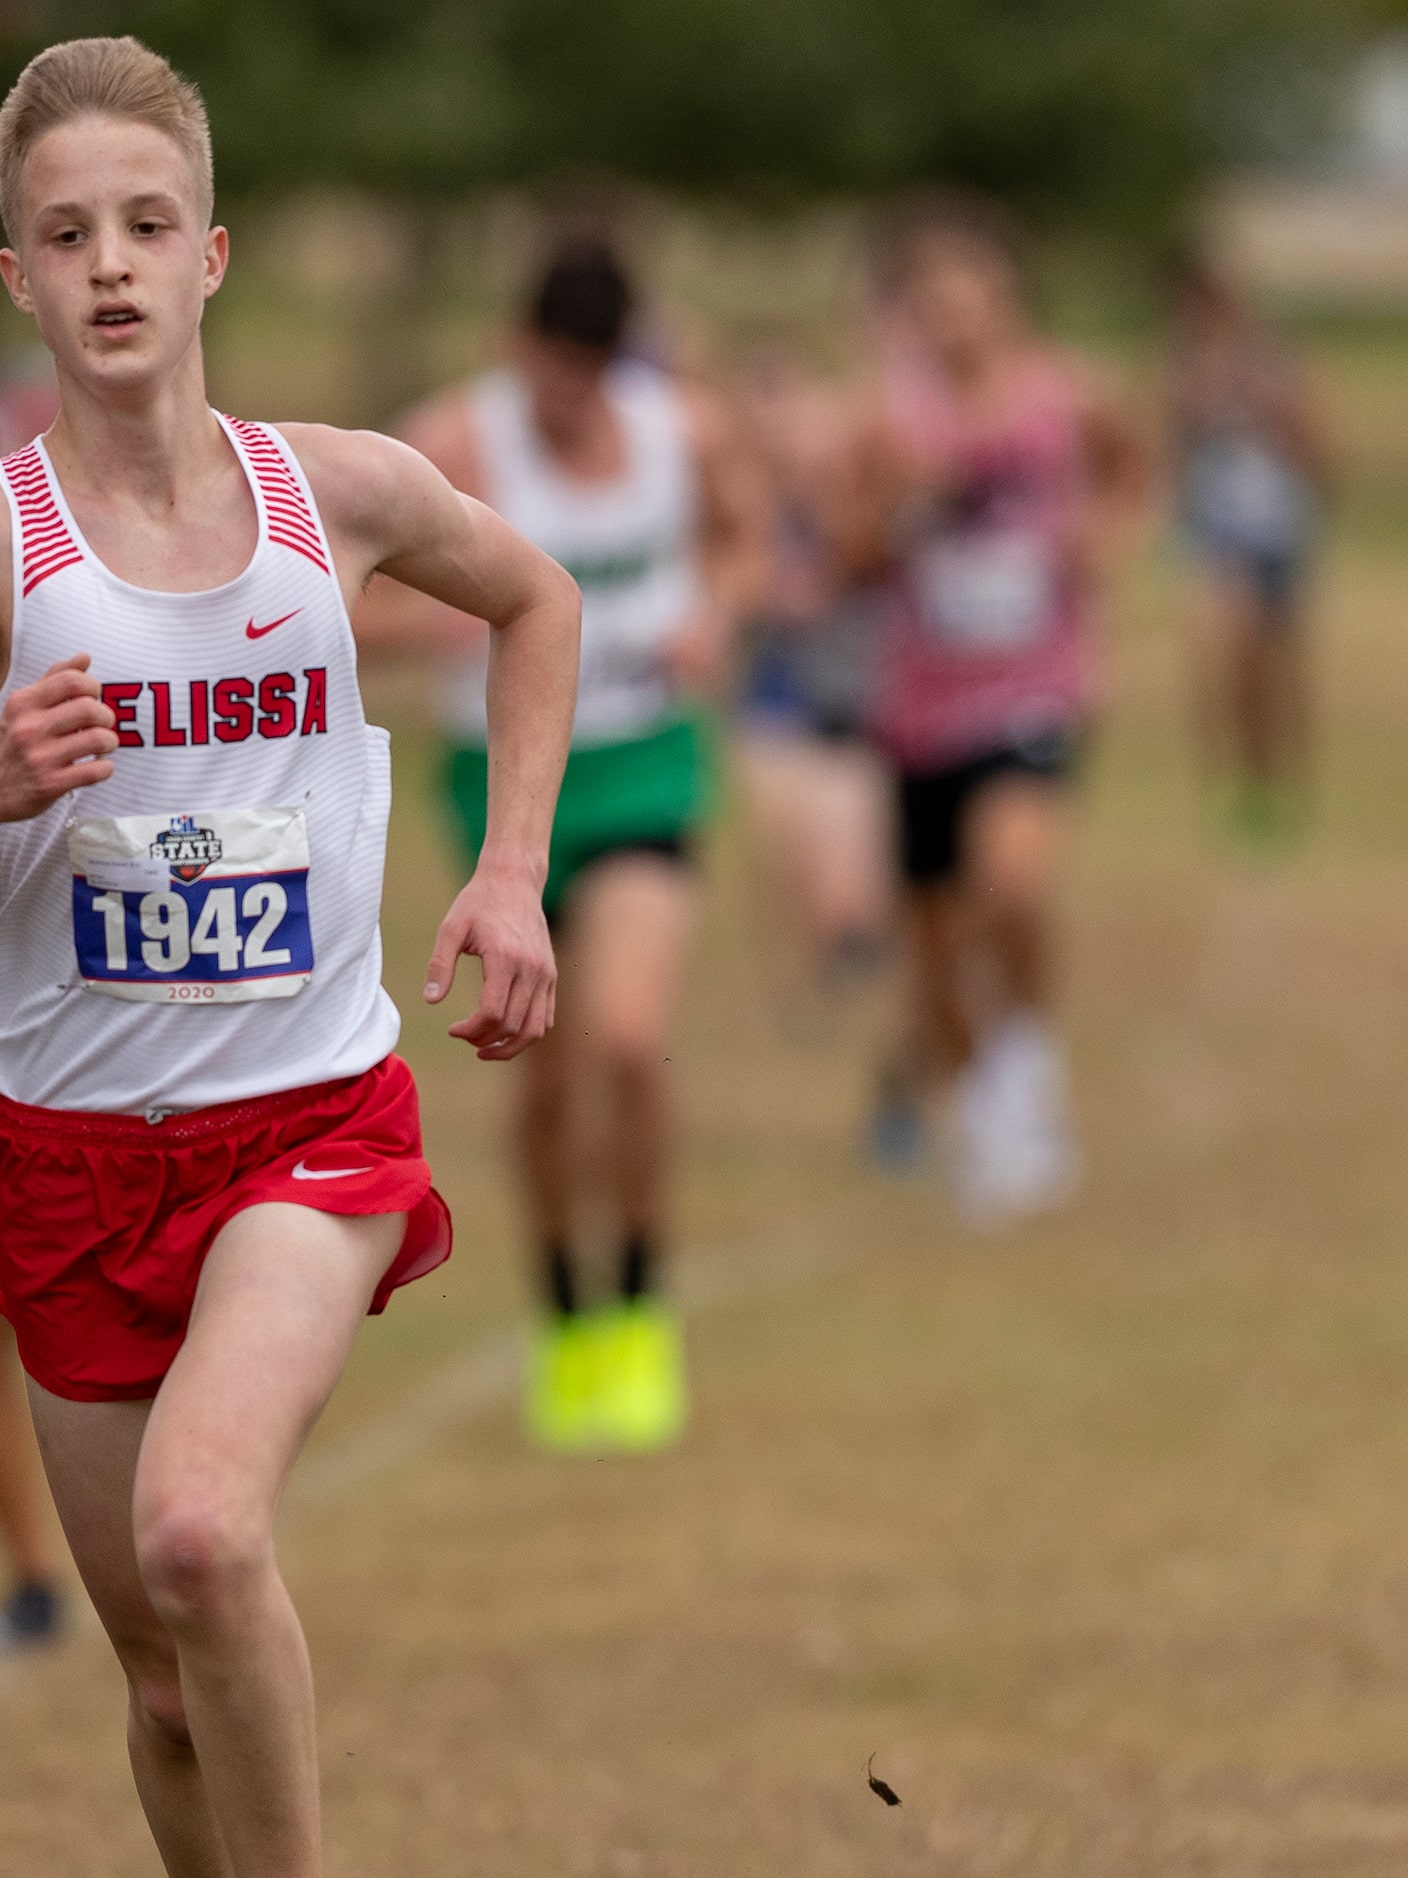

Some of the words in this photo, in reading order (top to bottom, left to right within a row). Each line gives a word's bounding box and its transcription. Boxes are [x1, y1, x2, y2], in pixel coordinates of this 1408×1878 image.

[101, 667, 327, 747] ELISSA
[151, 840, 221, 859] STATE
[92, 882, 292, 973] 1942
[168, 986, 215, 999] 2020
